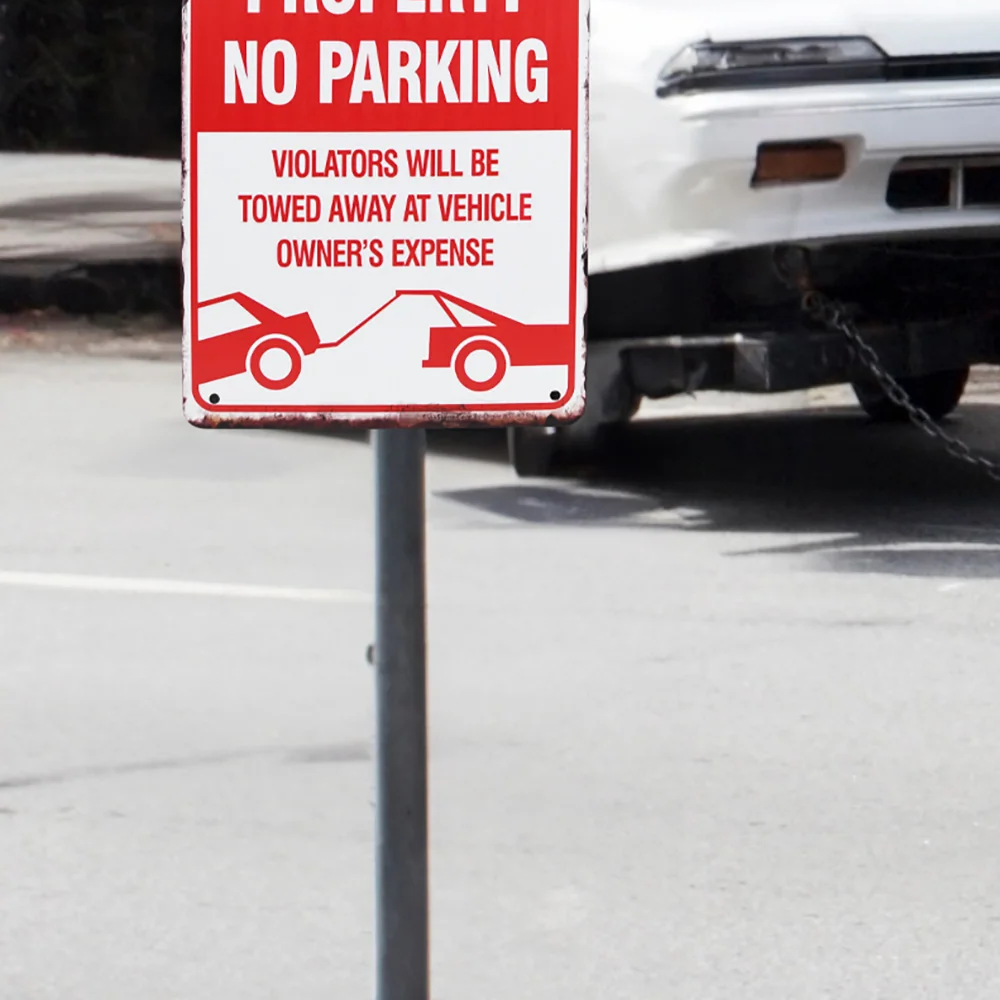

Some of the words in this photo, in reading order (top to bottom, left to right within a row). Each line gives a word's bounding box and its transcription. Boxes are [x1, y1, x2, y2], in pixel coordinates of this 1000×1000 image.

[225, 39, 297, 105] NO
[320, 38, 548, 104] PARKING
[272, 149, 398, 178] VIOLATORS
[406, 149, 463, 177] WILL
[472, 149, 498, 176] BE
[238, 195, 321, 223] TOWED
[329, 195, 396, 222] AWAY
[404, 194, 431, 222] AT
[438, 193, 531, 221] VEHICLE
[277, 239, 383, 267] OWNER'S
[392, 238, 493, 266] EXPENSE
